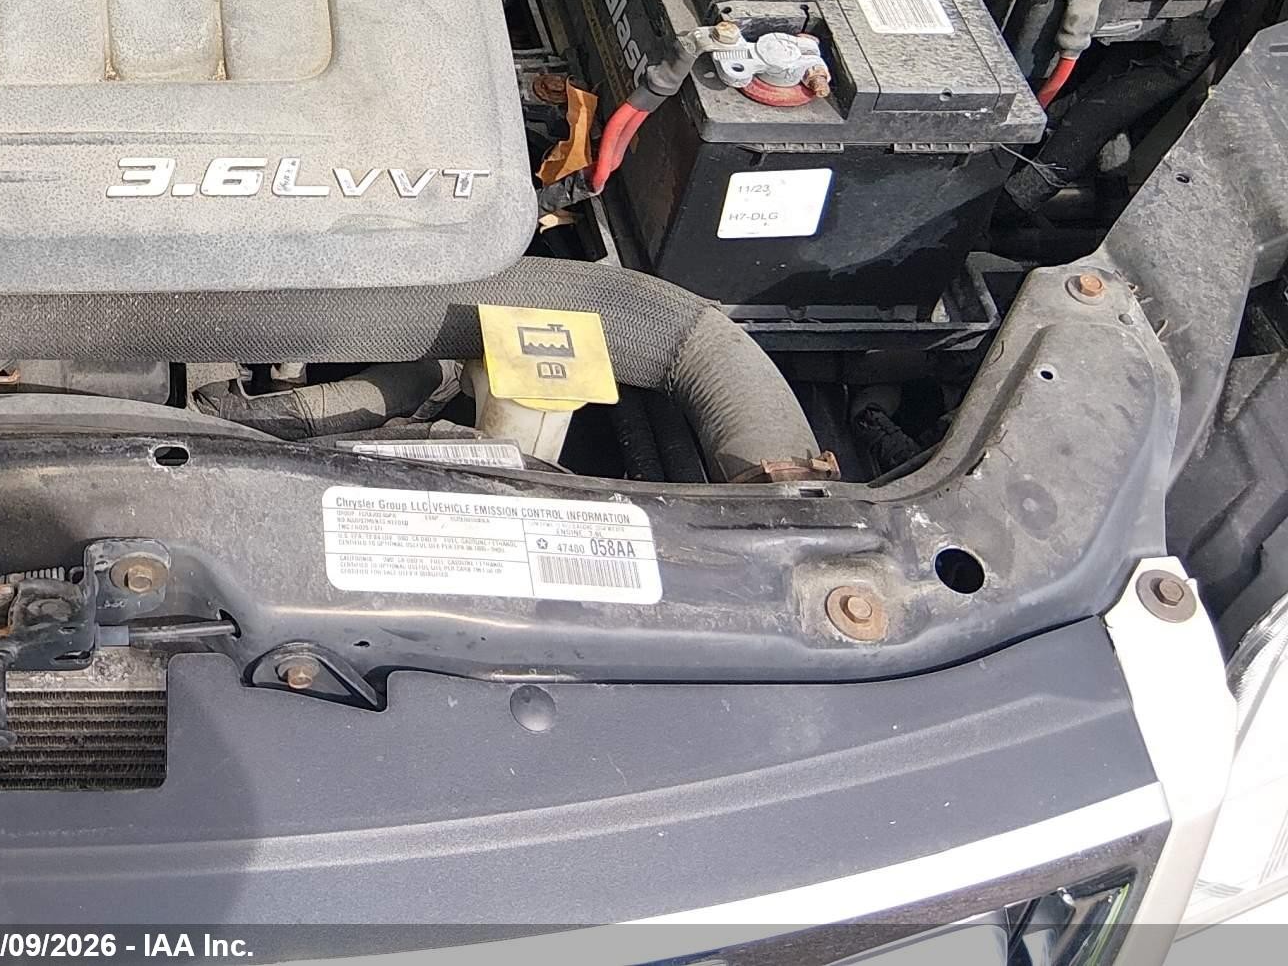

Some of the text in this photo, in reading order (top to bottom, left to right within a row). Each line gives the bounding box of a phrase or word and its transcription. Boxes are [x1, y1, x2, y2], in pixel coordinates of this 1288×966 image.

[332, 168, 490, 198] VVT
[738, 184, 770, 193] 11/23
[729, 212, 779, 221] H7-DLG
[335, 497, 428, 512] Chrysler Group LLC
[432, 503, 631, 524] VEHICLE EMISSION CONTROL INFORMATION
[590, 538, 636, 557] 058AA
